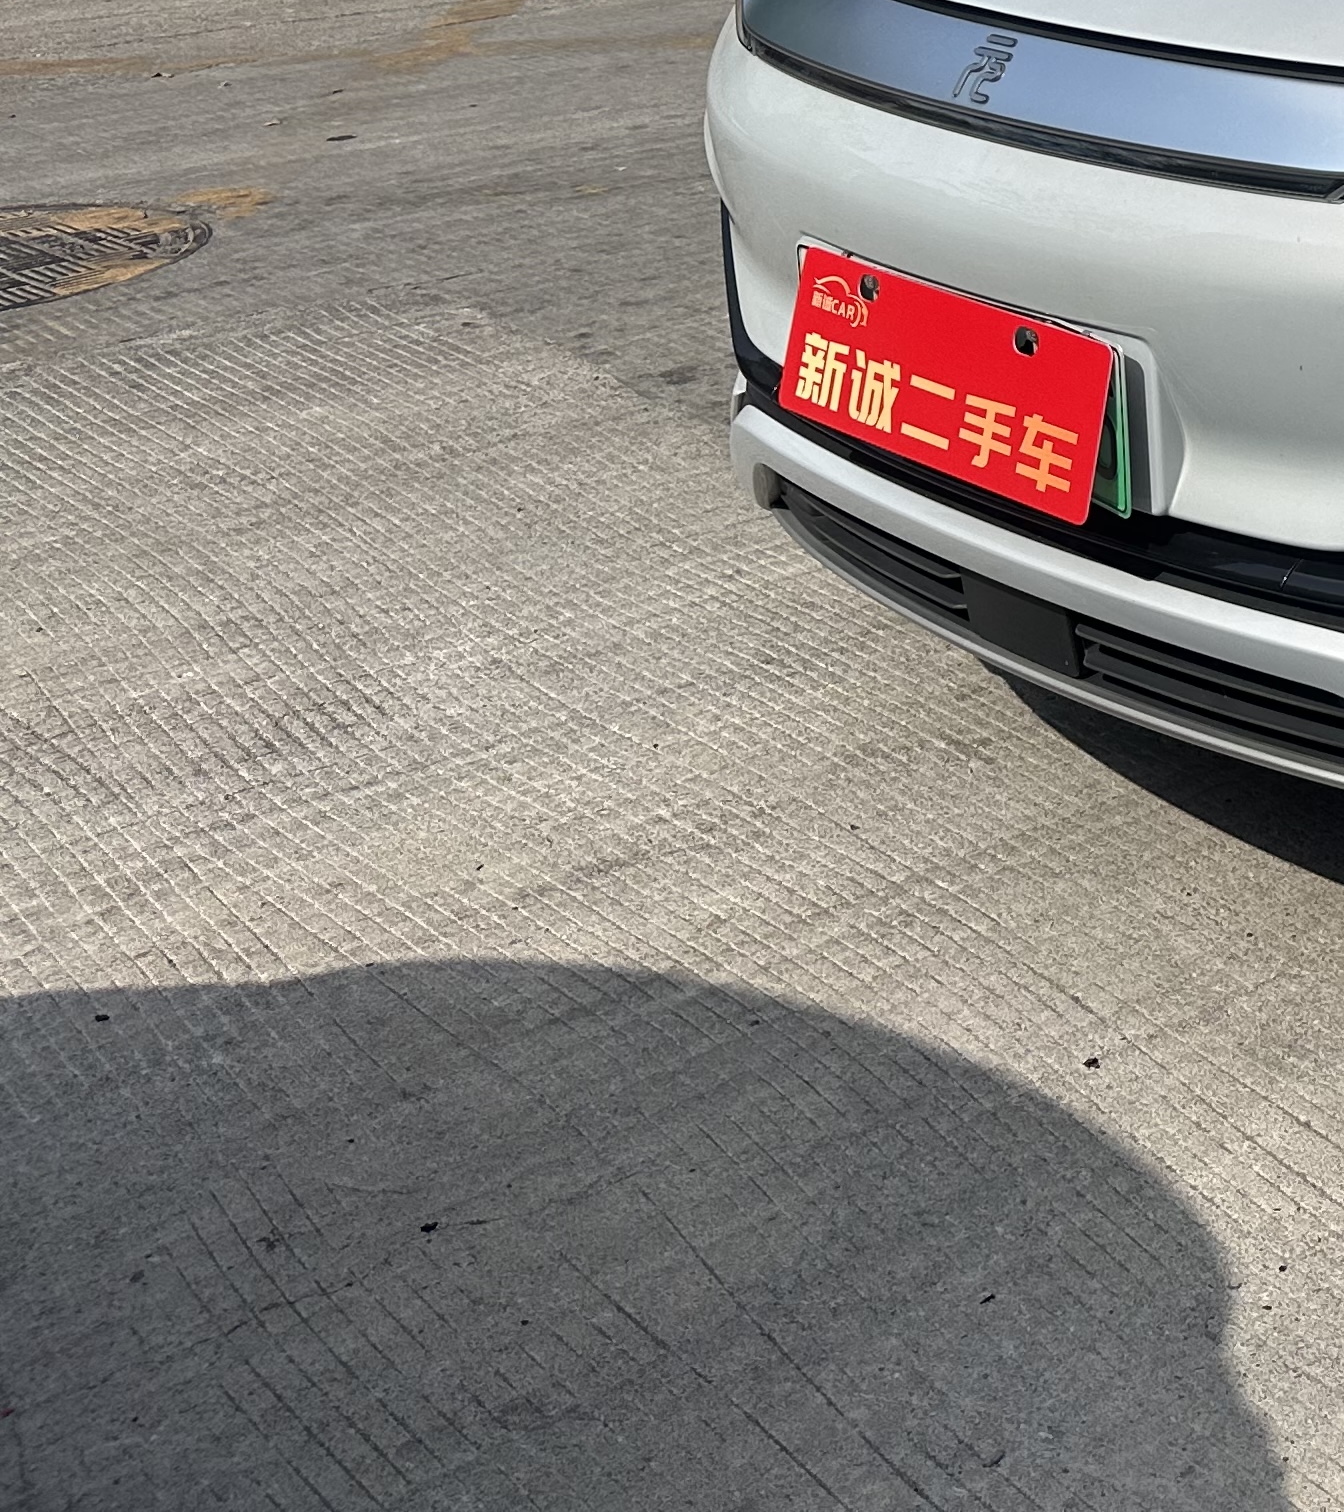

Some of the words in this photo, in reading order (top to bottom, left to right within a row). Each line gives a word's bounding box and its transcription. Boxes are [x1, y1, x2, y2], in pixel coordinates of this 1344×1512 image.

[811, 290, 855, 322] 新诚CAR
[795, 331, 1079, 494] 新诚二手车
